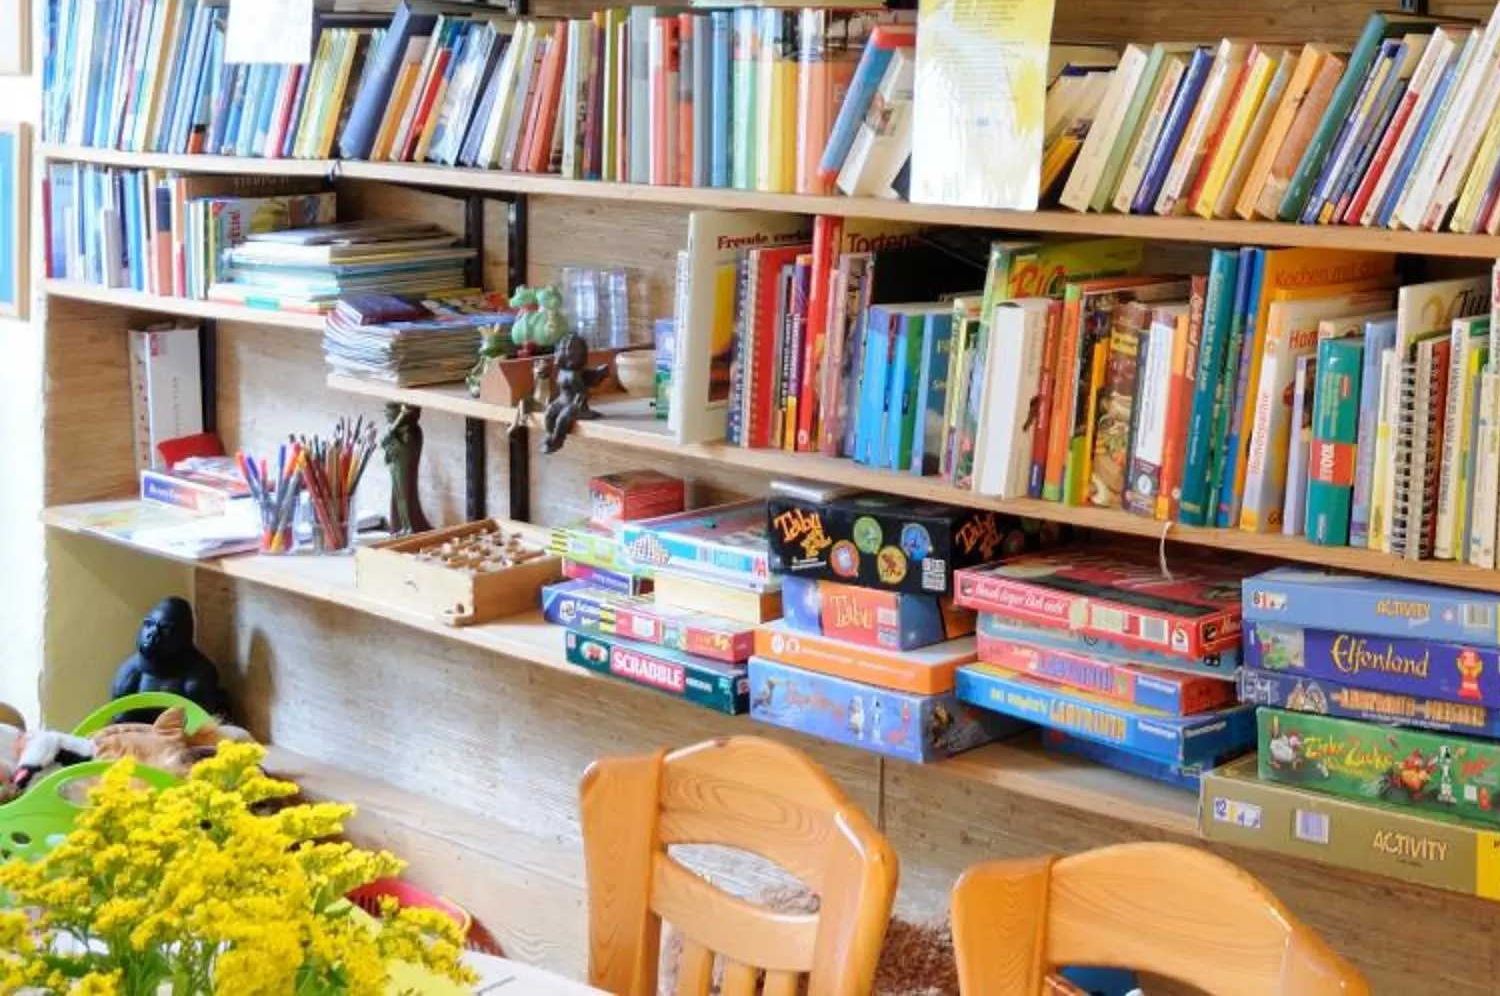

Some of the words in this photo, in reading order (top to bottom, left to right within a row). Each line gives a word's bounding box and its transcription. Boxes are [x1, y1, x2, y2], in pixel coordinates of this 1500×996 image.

[829, 594, 875, 631] Tabu
[1376, 600, 1431, 619] ACTIVITY
[612, 648, 685, 690] SCRABBLE
[1330, 634, 1430, 679] Elfenland
[1372, 830, 1450, 862] ACTIVITY
